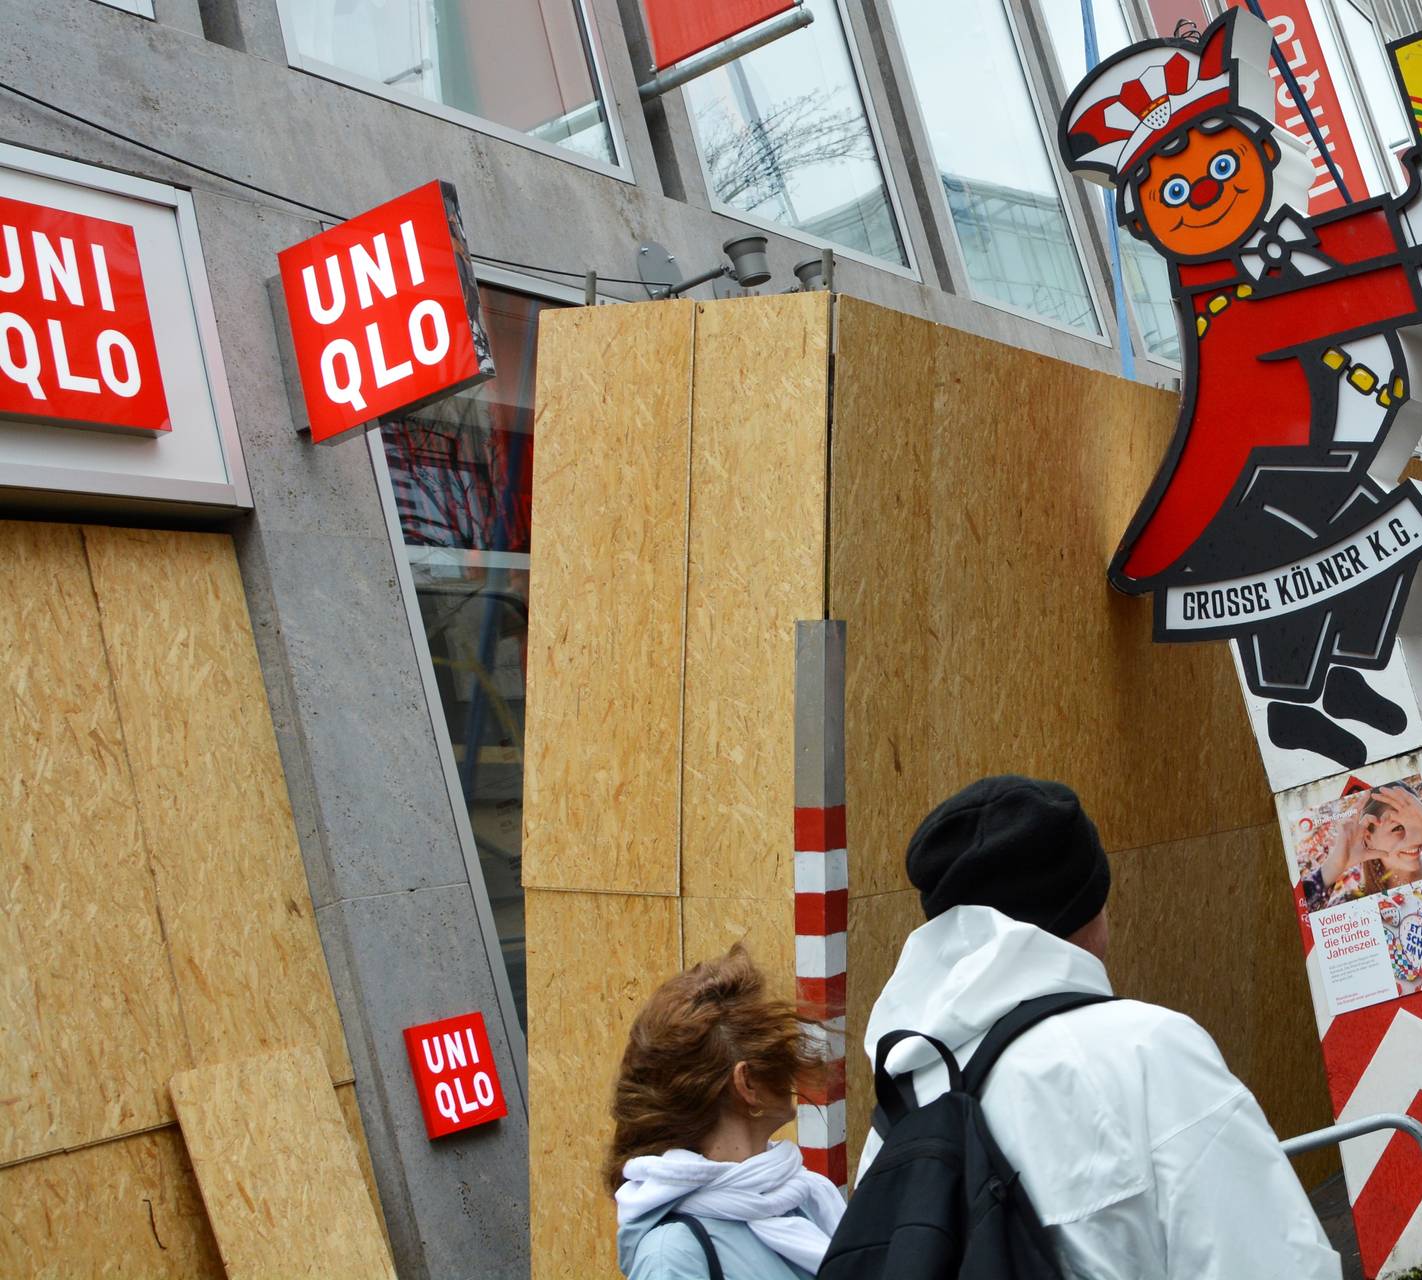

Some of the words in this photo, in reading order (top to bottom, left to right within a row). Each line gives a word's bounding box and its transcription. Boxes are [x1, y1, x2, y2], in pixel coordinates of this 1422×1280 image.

[0, 224, 115, 312] UNI
[302, 219, 425, 326] UNI
[0, 312, 142, 400] QLO
[320, 299, 450, 412] QLO
[1182, 581, 1271, 621] GROSSE
[1274, 544, 1369, 605] KÖLNER
[1366, 517, 1420, 561] K.G.
[1318, 913, 1346, 926] Voller
[1321, 920, 1359, 937] Energie
[1360, 917, 1370, 926] in
[1324, 938, 1339, 949] die
[1341, 929, 1370, 943] fünfte
[421, 1028, 480, 1074] UNI
[434, 1071, 495, 1123] QLO
